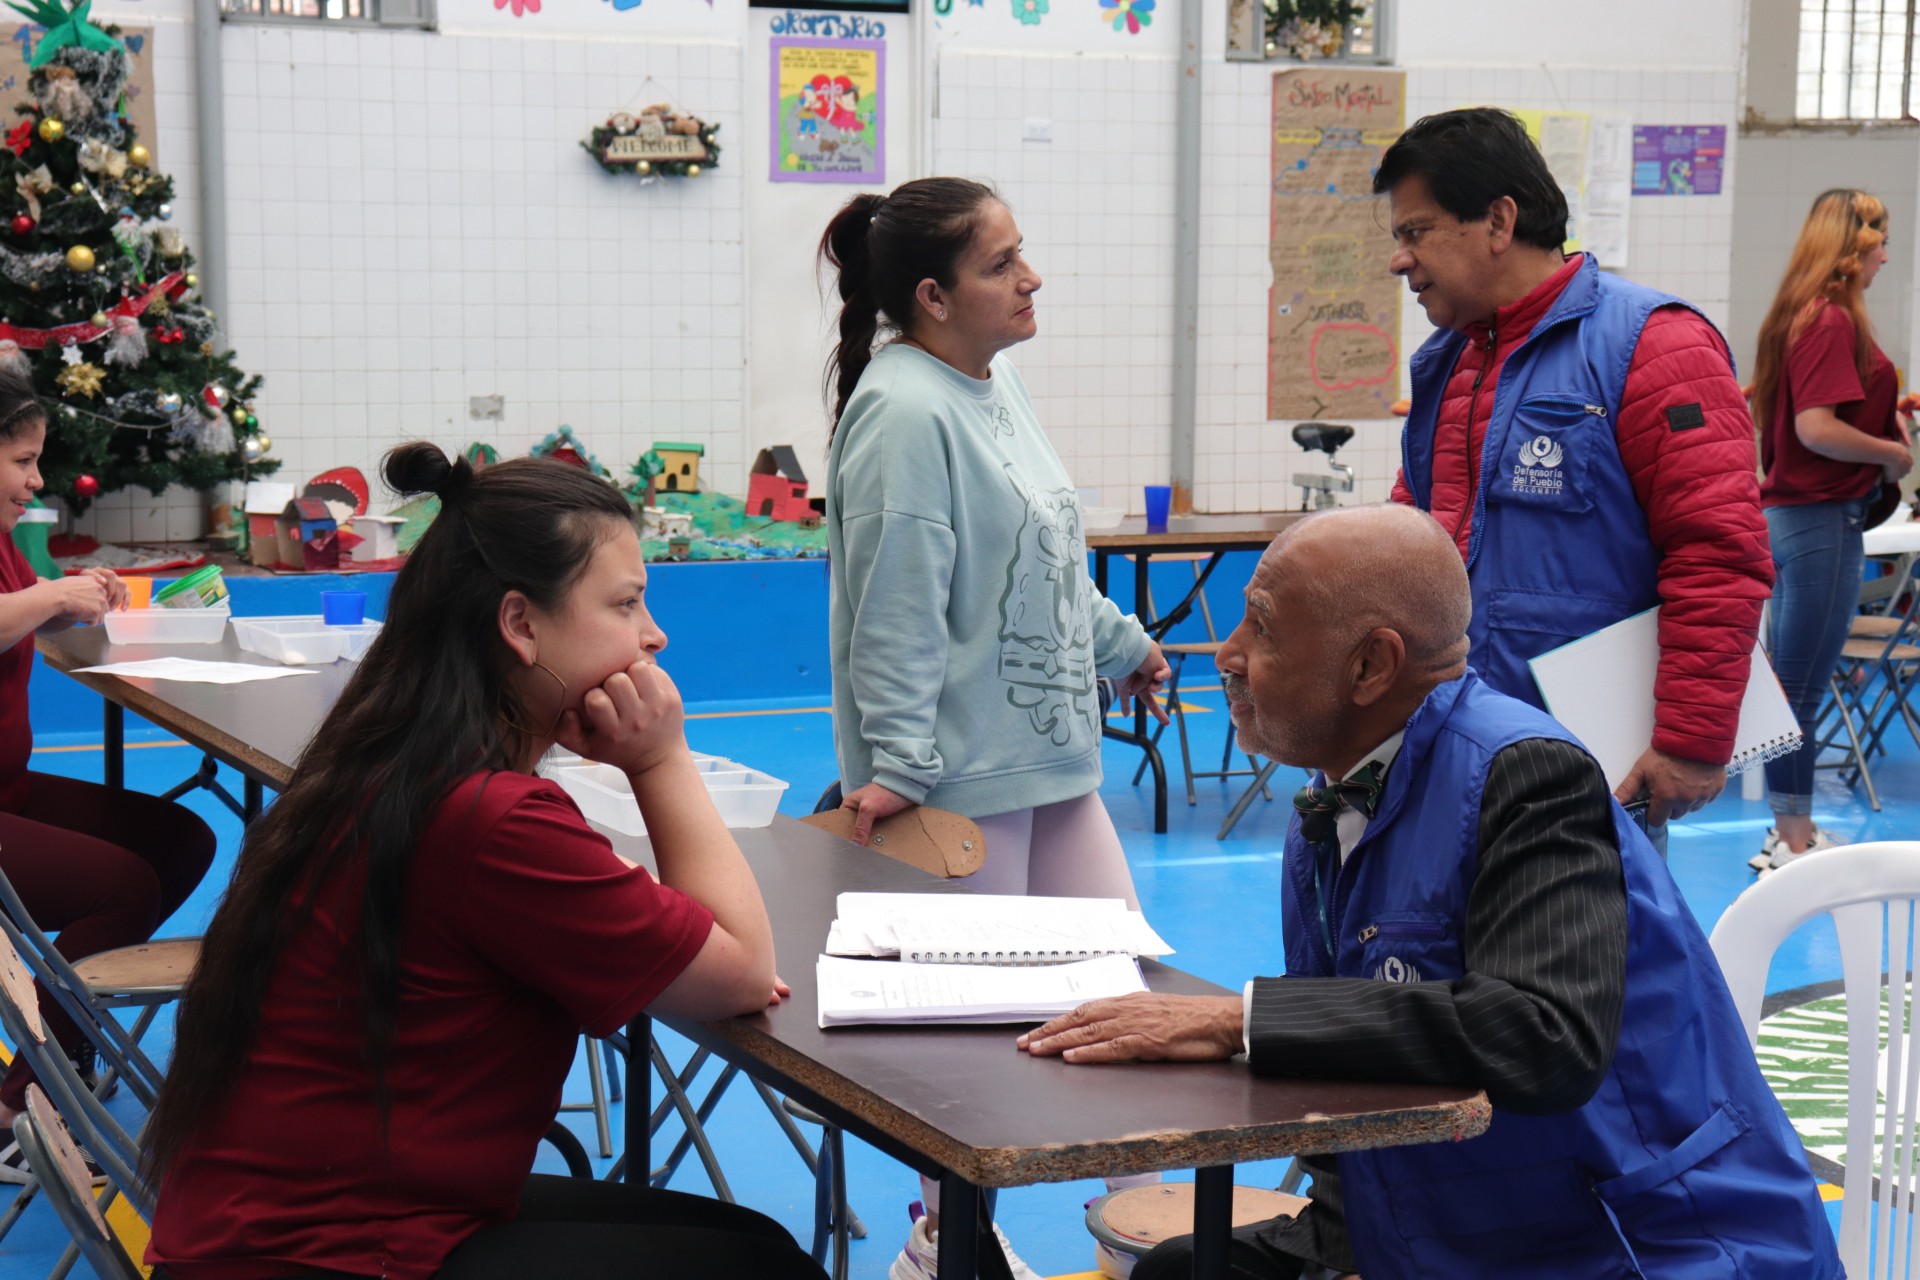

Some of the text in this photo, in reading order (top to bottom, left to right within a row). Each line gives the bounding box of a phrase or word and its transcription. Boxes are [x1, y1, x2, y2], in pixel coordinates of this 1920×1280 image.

[613, 140, 693, 153] WELCOME
[1513, 475, 1563, 487] del Pueblo
[1512, 485, 1561, 495] COLOMBIA
